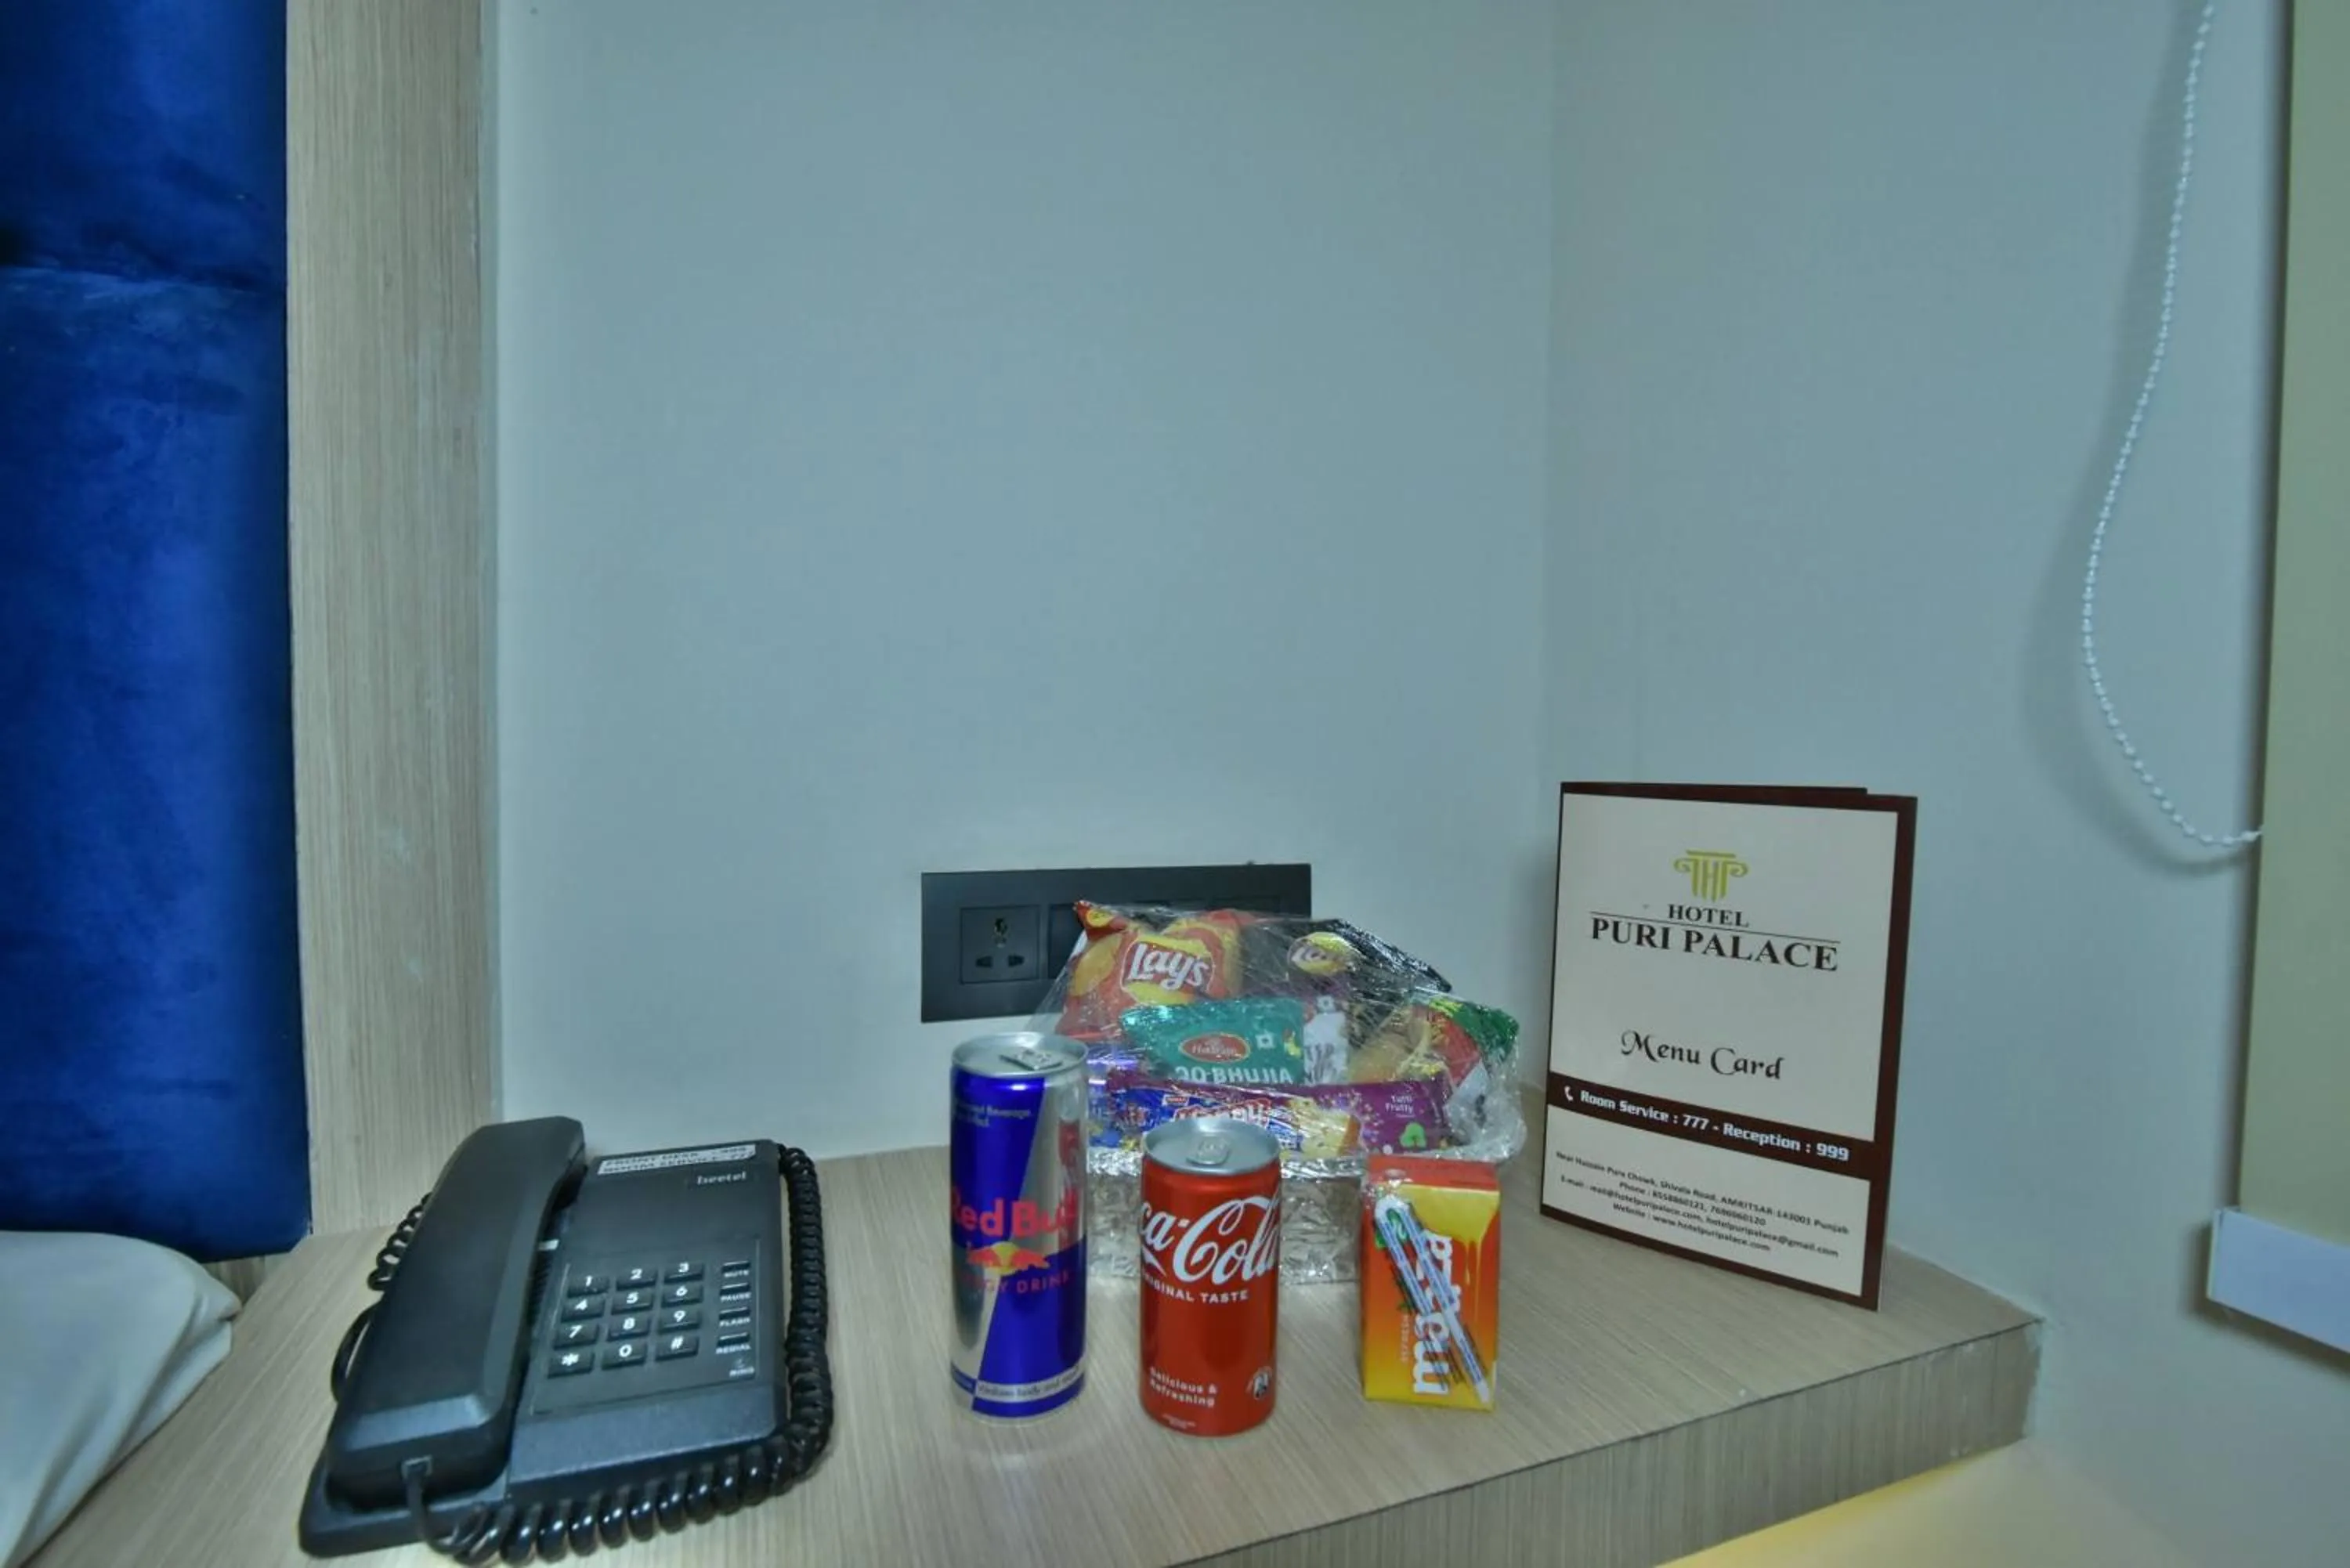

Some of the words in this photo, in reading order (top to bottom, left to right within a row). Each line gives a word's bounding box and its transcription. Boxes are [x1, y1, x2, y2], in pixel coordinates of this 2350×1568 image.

[1668, 904, 1748, 927] HOTEL
[1592, 917, 1670, 949] PURI
[1683, 930, 1838, 971] PALACE
[1621, 1031, 1701, 1064] Menu
[1710, 1047, 1785, 1080] Card
[1580, 1089, 1615, 1110] Room
[1619, 1100, 1669, 1122] Service
[1683, 1115, 1709, 1131] 777
[1723, 1122, 1801, 1151] Reception
[1816, 1142, 1849, 1162] 999
[952, 1187, 1004, 1237] ed
[630, 1268, 642, 1280] 2
[678, 1262, 689, 1273] 3
[586, 1275, 593, 1287] 1
[676, 1285, 688, 1296] 6
[1201, 1289, 1249, 1303] TASTE
[574, 1299, 588, 1310] 4
[627, 1292, 638, 1304] 5
[674, 1310, 685, 1322] 9
[623, 1317, 635, 1330] 8
[569, 1324, 583, 1339] 7
